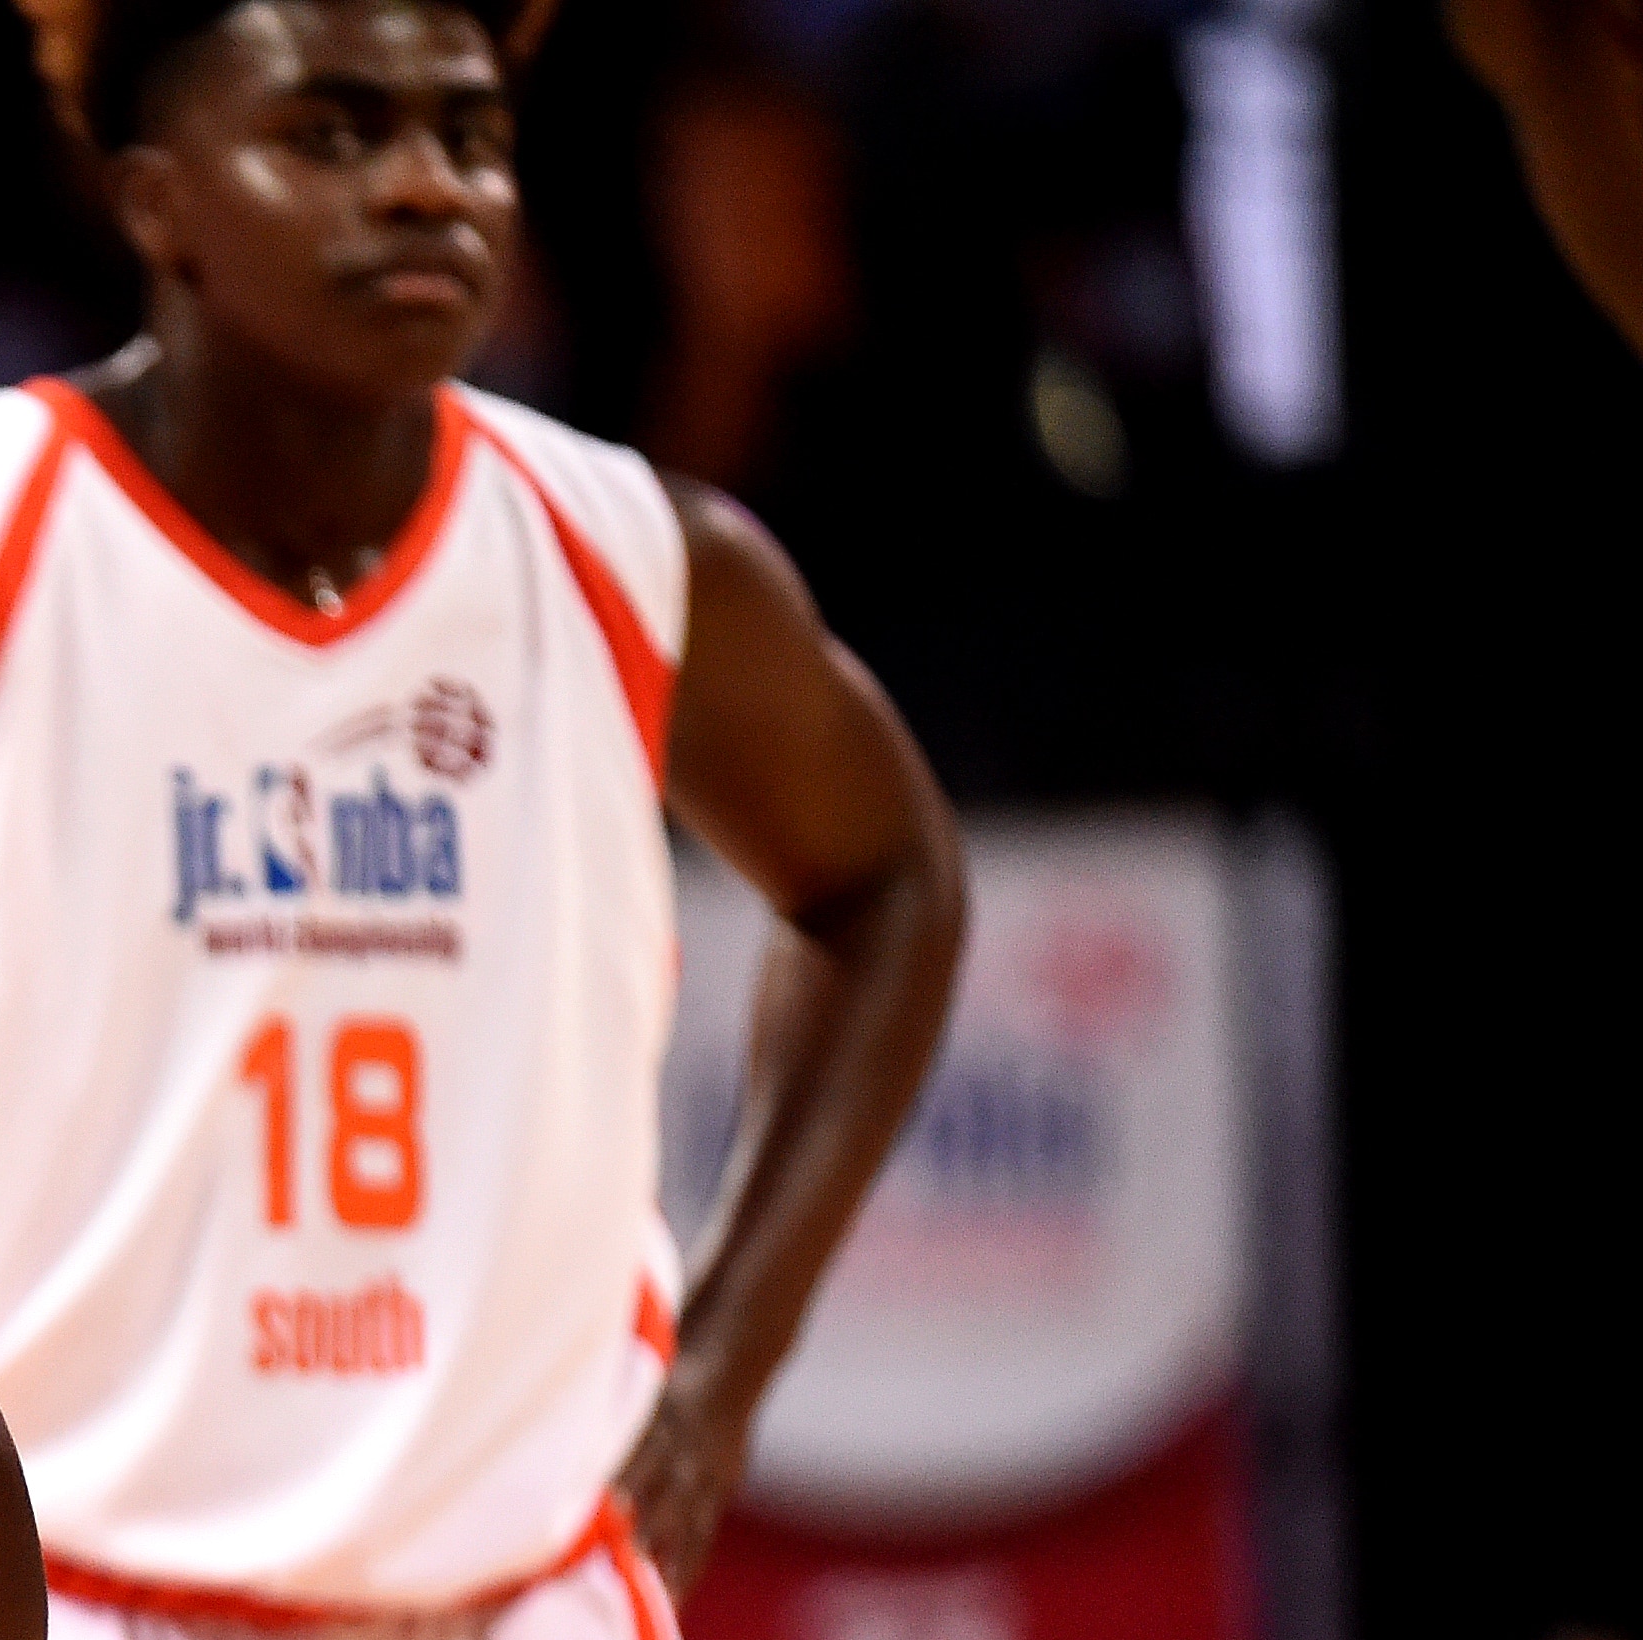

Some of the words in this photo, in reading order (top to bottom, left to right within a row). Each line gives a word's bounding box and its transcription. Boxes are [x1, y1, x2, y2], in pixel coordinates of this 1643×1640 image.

[170, 764, 247, 927] jr.
[329, 766, 461, 898] nba
[239, 1014, 424, 1231] 18
[250, 1278, 425, 1375] south
